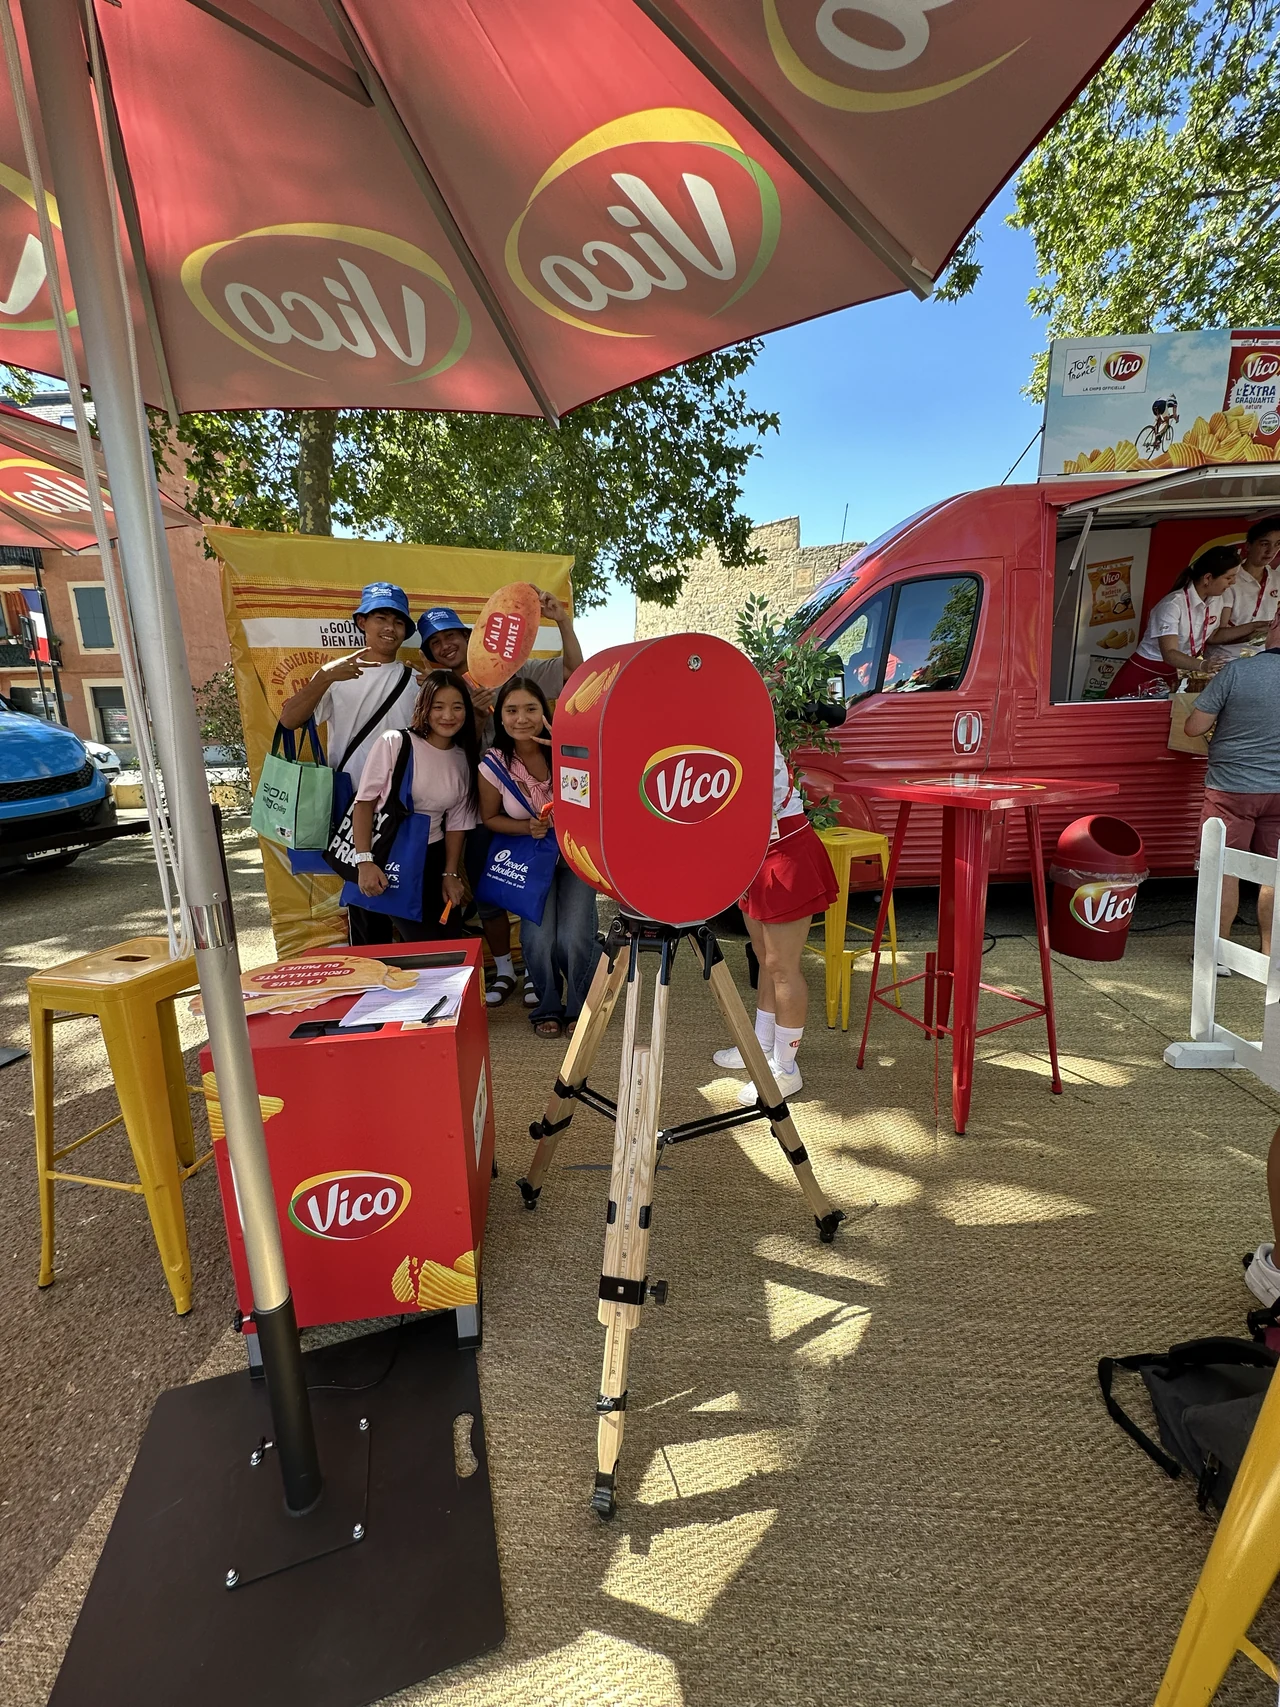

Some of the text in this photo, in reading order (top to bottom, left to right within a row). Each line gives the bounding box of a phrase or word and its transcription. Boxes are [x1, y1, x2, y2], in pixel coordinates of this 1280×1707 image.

[1109, 356, 1141, 378] Vico
[1247, 356, 1279, 379] Vico
[1236, 383, 1276, 397] L'EXTRA
[1235, 396, 1276, 404] CRAQUANTE
[1102, 573, 1120, 584] Vico
[320, 625, 329, 634] Le
[485, 616, 504, 650] J'AI LA
[503, 622, 520, 659] PATATE
[656, 758, 731, 814] Vico
[278, 963, 322, 972] PAQUET
[254, 969, 352, 982] CROUSTILLANTE
[268, 979, 304, 988] PLUS
[307, 1182, 397, 1232] Vico
